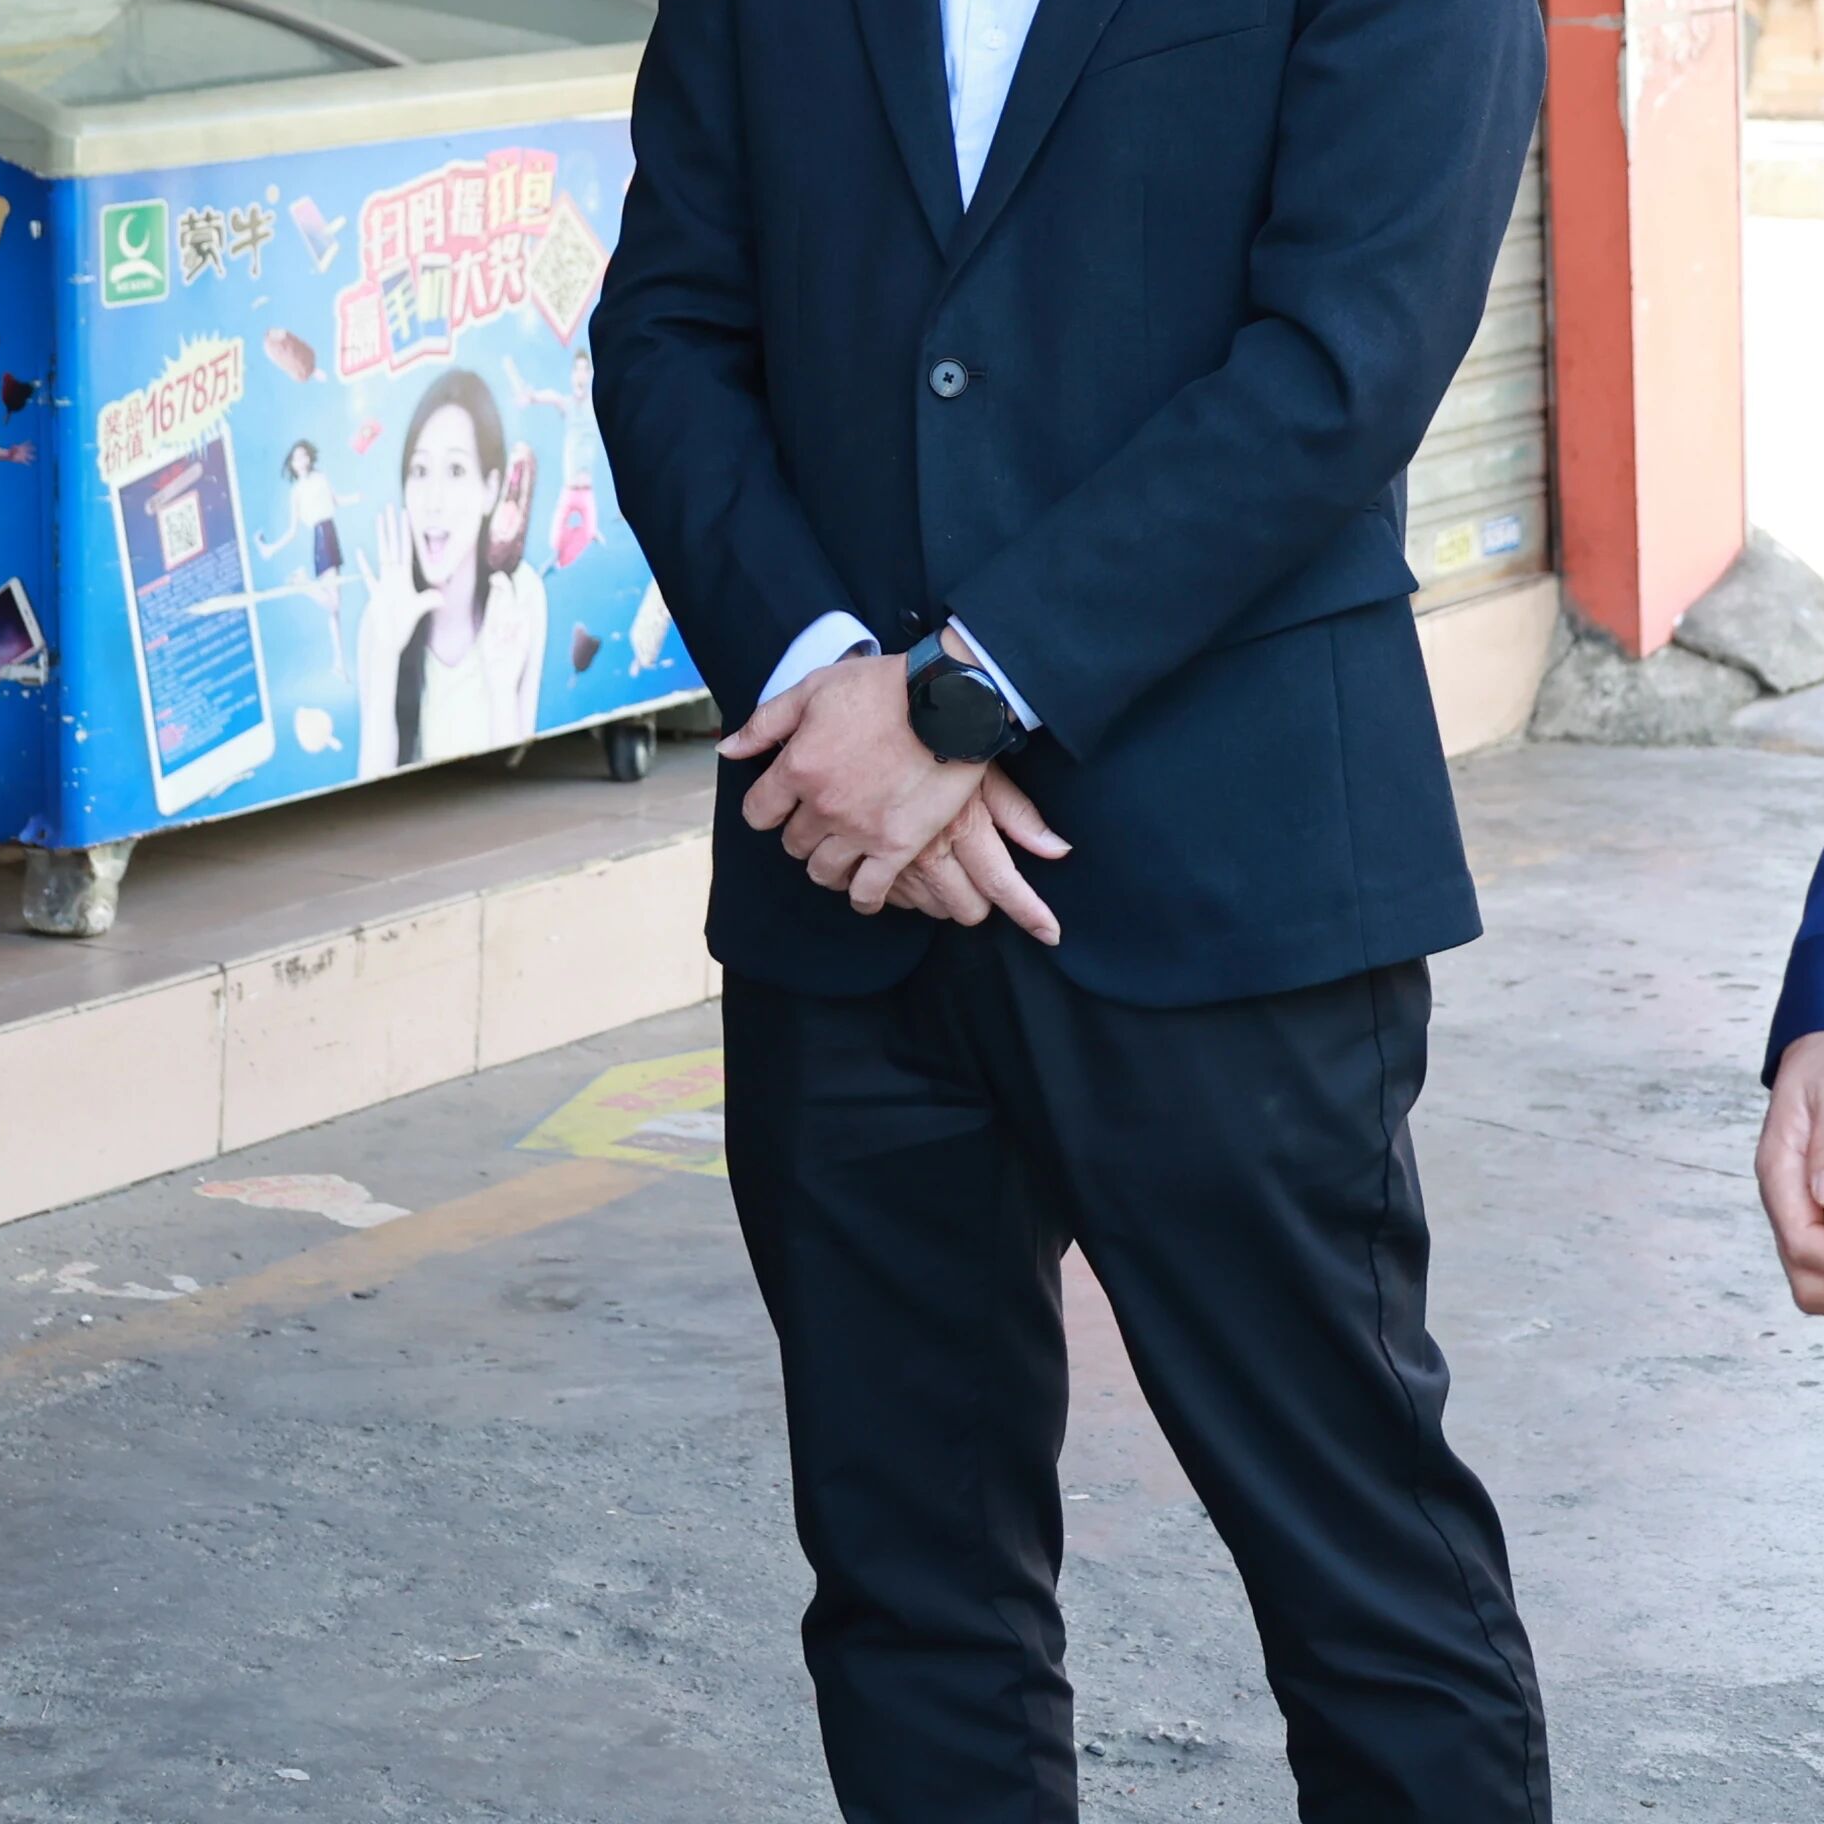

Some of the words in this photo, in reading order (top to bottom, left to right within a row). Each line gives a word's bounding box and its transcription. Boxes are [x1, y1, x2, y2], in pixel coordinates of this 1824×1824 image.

[179, 204, 274, 283] 蒙牛
[370, 163, 556, 268] 扫码摇红包
[342, 237, 526, 364] 赢手机大奖
[103, 399, 143, 437] 奖品
